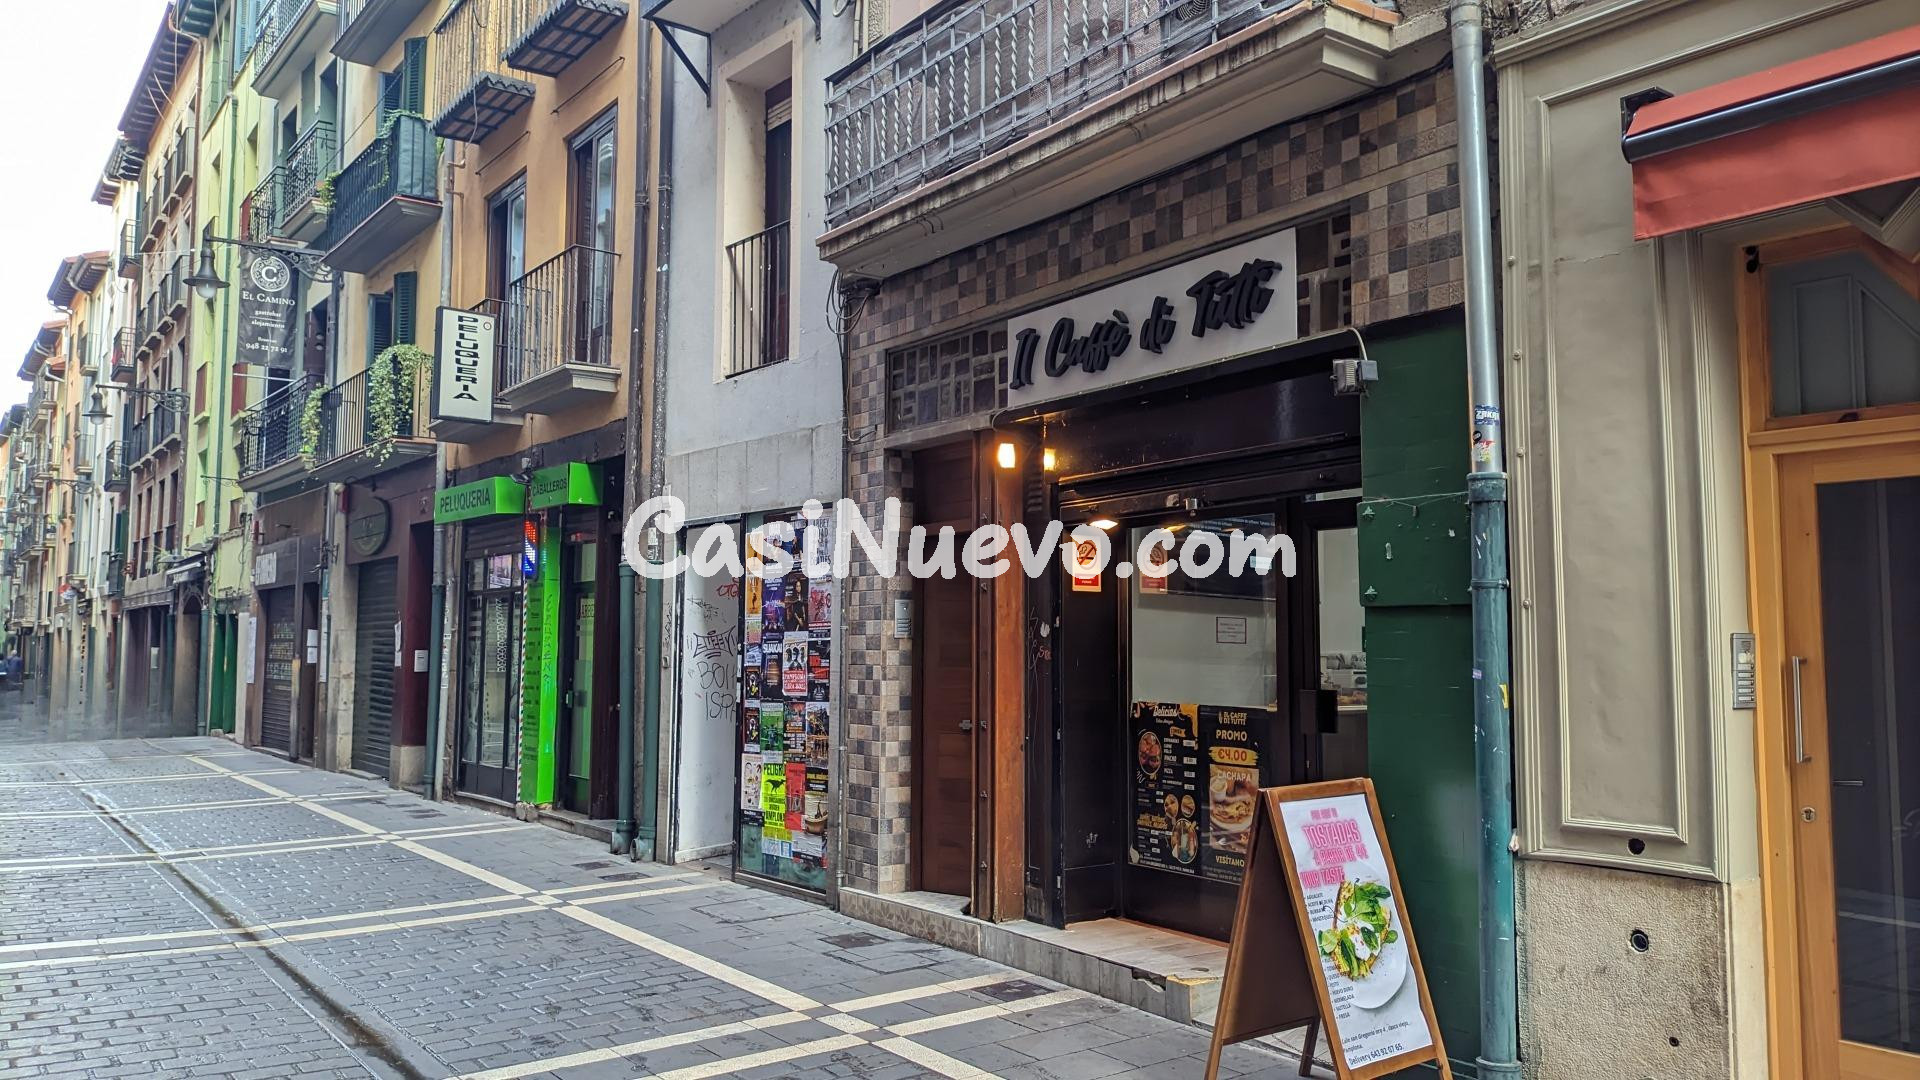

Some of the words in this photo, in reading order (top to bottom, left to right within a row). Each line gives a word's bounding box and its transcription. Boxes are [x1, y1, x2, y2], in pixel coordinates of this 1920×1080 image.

[1140, 296, 1176, 354] di
[1186, 258, 1282, 338] Tutti
[245, 342, 260, 350] 948
[453, 315, 480, 402] PELUQUERIA
[532, 478, 568, 498] CABALLEROS
[439, 487, 491, 514] PELUQUERIA
[1215, 729, 1247, 741] PROMO
[1217, 748, 1247, 761] €4.00
[1217, 771, 1251, 782] CACHAPA
[1302, 820, 1361, 849] TOSTADAS
[1321, 865, 1345, 885] TASTE
[1349, 1053, 1371, 1066] Delivery
[1371, 1050, 1381, 1058] 643
[1381, 1048, 1388, 1056] 92
